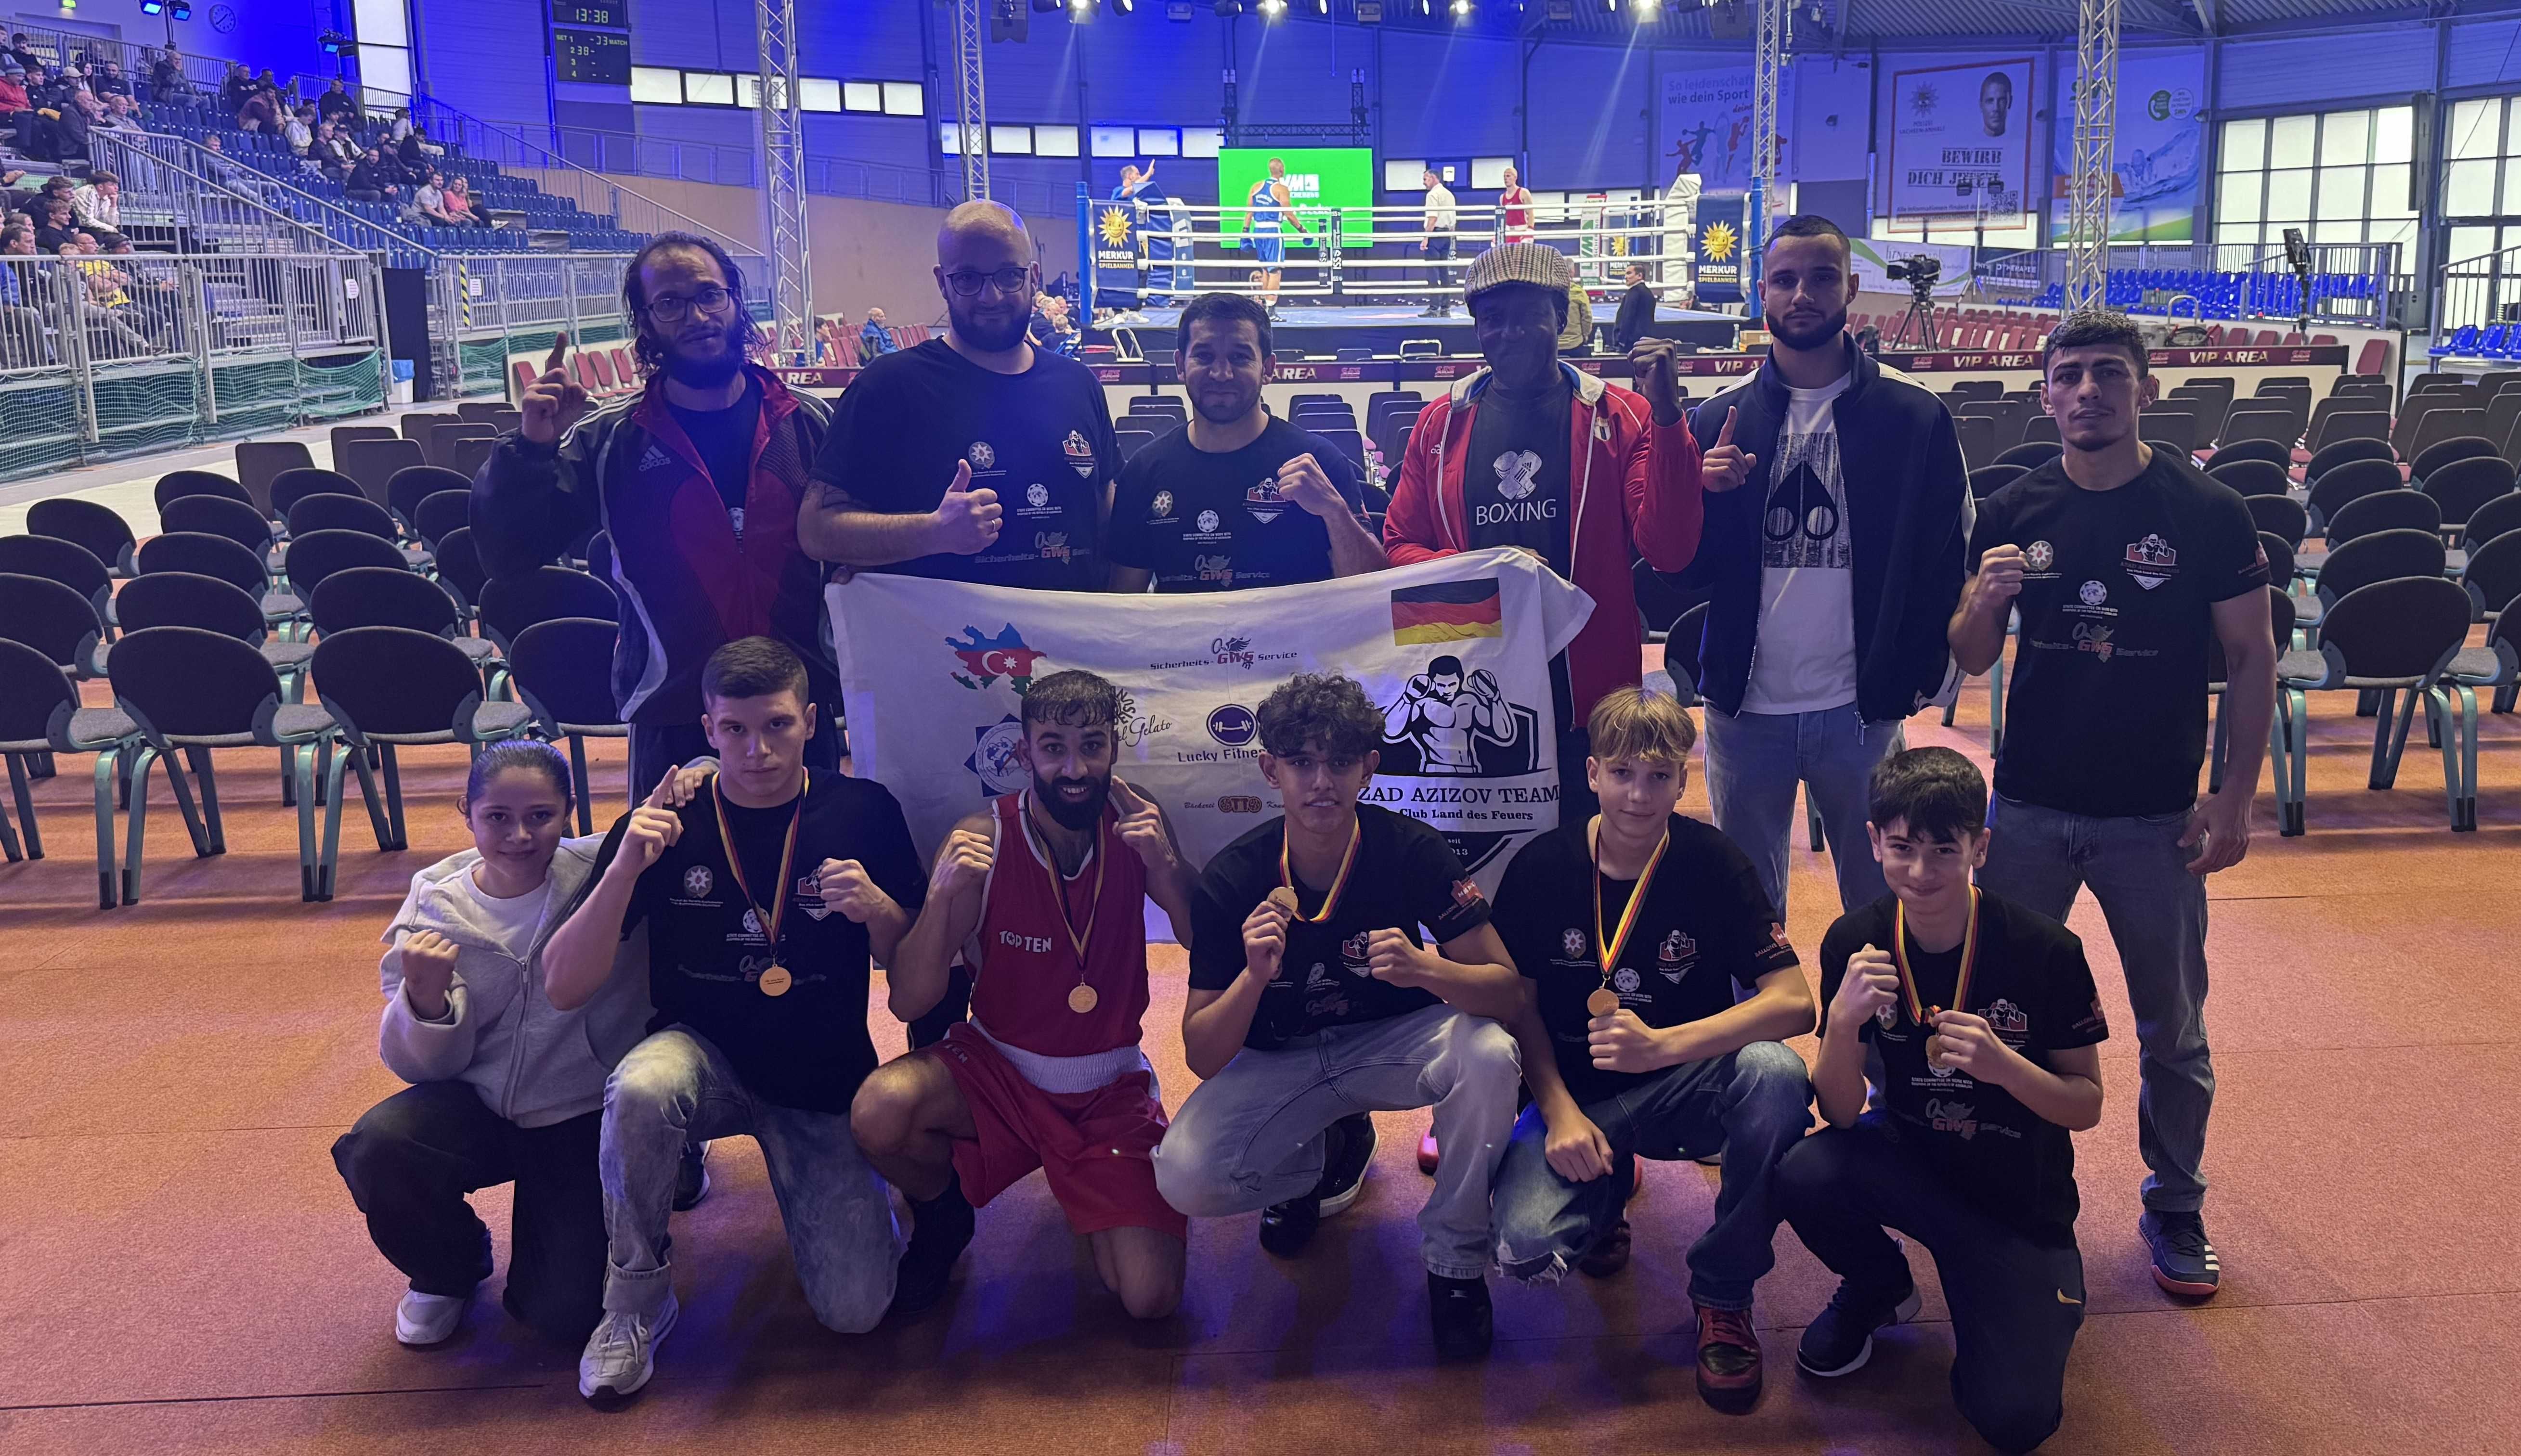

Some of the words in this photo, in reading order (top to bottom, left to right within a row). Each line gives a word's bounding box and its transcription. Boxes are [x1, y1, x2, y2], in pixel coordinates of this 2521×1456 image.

[576, 8, 608, 24] 13:38
[1668, 80, 1682, 91] So
[1668, 92, 1688, 104] wie
[1690, 90, 1714, 103] dein
[1717, 89, 1749, 102] Sport
[1942, 150, 2001, 164] BEWIRB
[1908, 171, 1943, 184] DICH
[1098, 250, 1133, 259] MERKUR
[1699, 265, 1737, 274] MERKUR
[1953, 356, 1981, 368] VIP
[1985, 355, 2034, 367] AREA
[2190, 352, 2218, 363] VIP
[2224, 351, 2268, 363] AREA
[1715, 361, 1744, 373] VIP
[1272, 368, 1317, 380] AREA
[639, 457, 671, 472] adidas
[1476, 499, 1556, 526] BOXING
[1150, 659, 1214, 670] Sicherheits-
[1218, 651, 1254, 665] GWS
[1258, 651, 1298, 661] Service
[1125, 715, 1172, 747] Gelato
[1178, 750, 1218, 762] Lucky
[1358, 786, 1403, 802] ZAD
[1411, 788, 1492, 804] AZIZOV
[1498, 785, 1560, 803] TEAM
[1400, 808, 1428, 818] Club
[1432, 809, 1463, 819] Land
[1467, 810, 1487, 819] des
[1492, 811, 1533, 820] Feuers
[999, 930, 1022, 948] TOP
[1025, 936, 1052, 953] TEN
